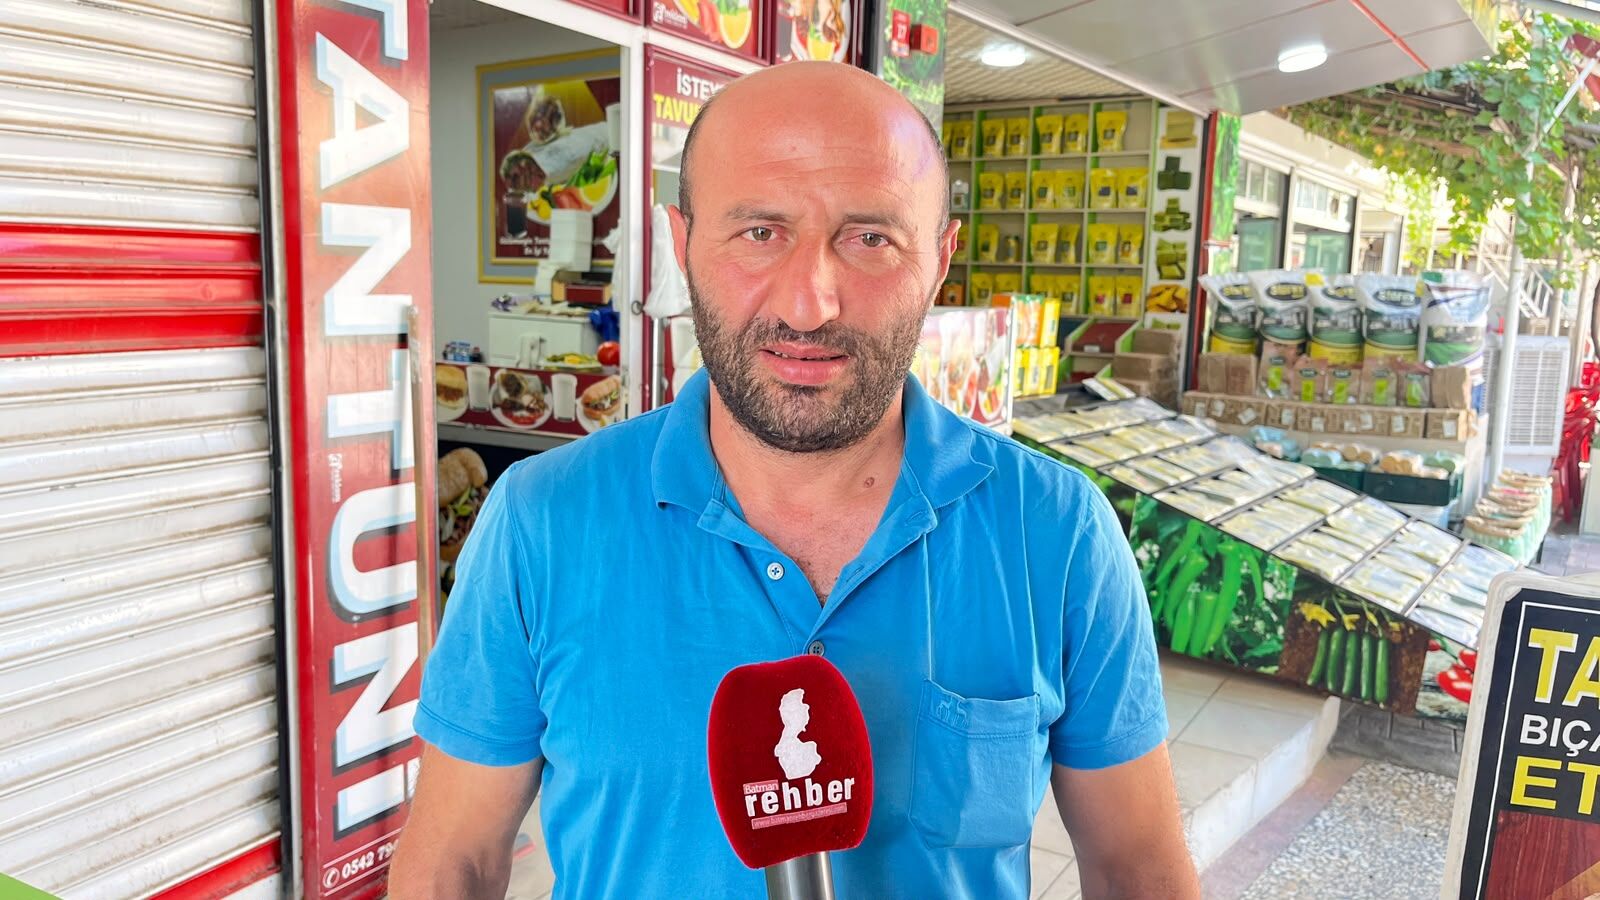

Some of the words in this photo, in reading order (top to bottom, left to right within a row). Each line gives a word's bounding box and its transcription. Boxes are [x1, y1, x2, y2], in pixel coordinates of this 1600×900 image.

[1519, 714, 1600, 757] BIÇ
[745, 783, 778, 794] Batman
[745, 777, 855, 817] rehber
[1510, 756, 1600, 815] ET
[341, 851, 375, 879] 0542
